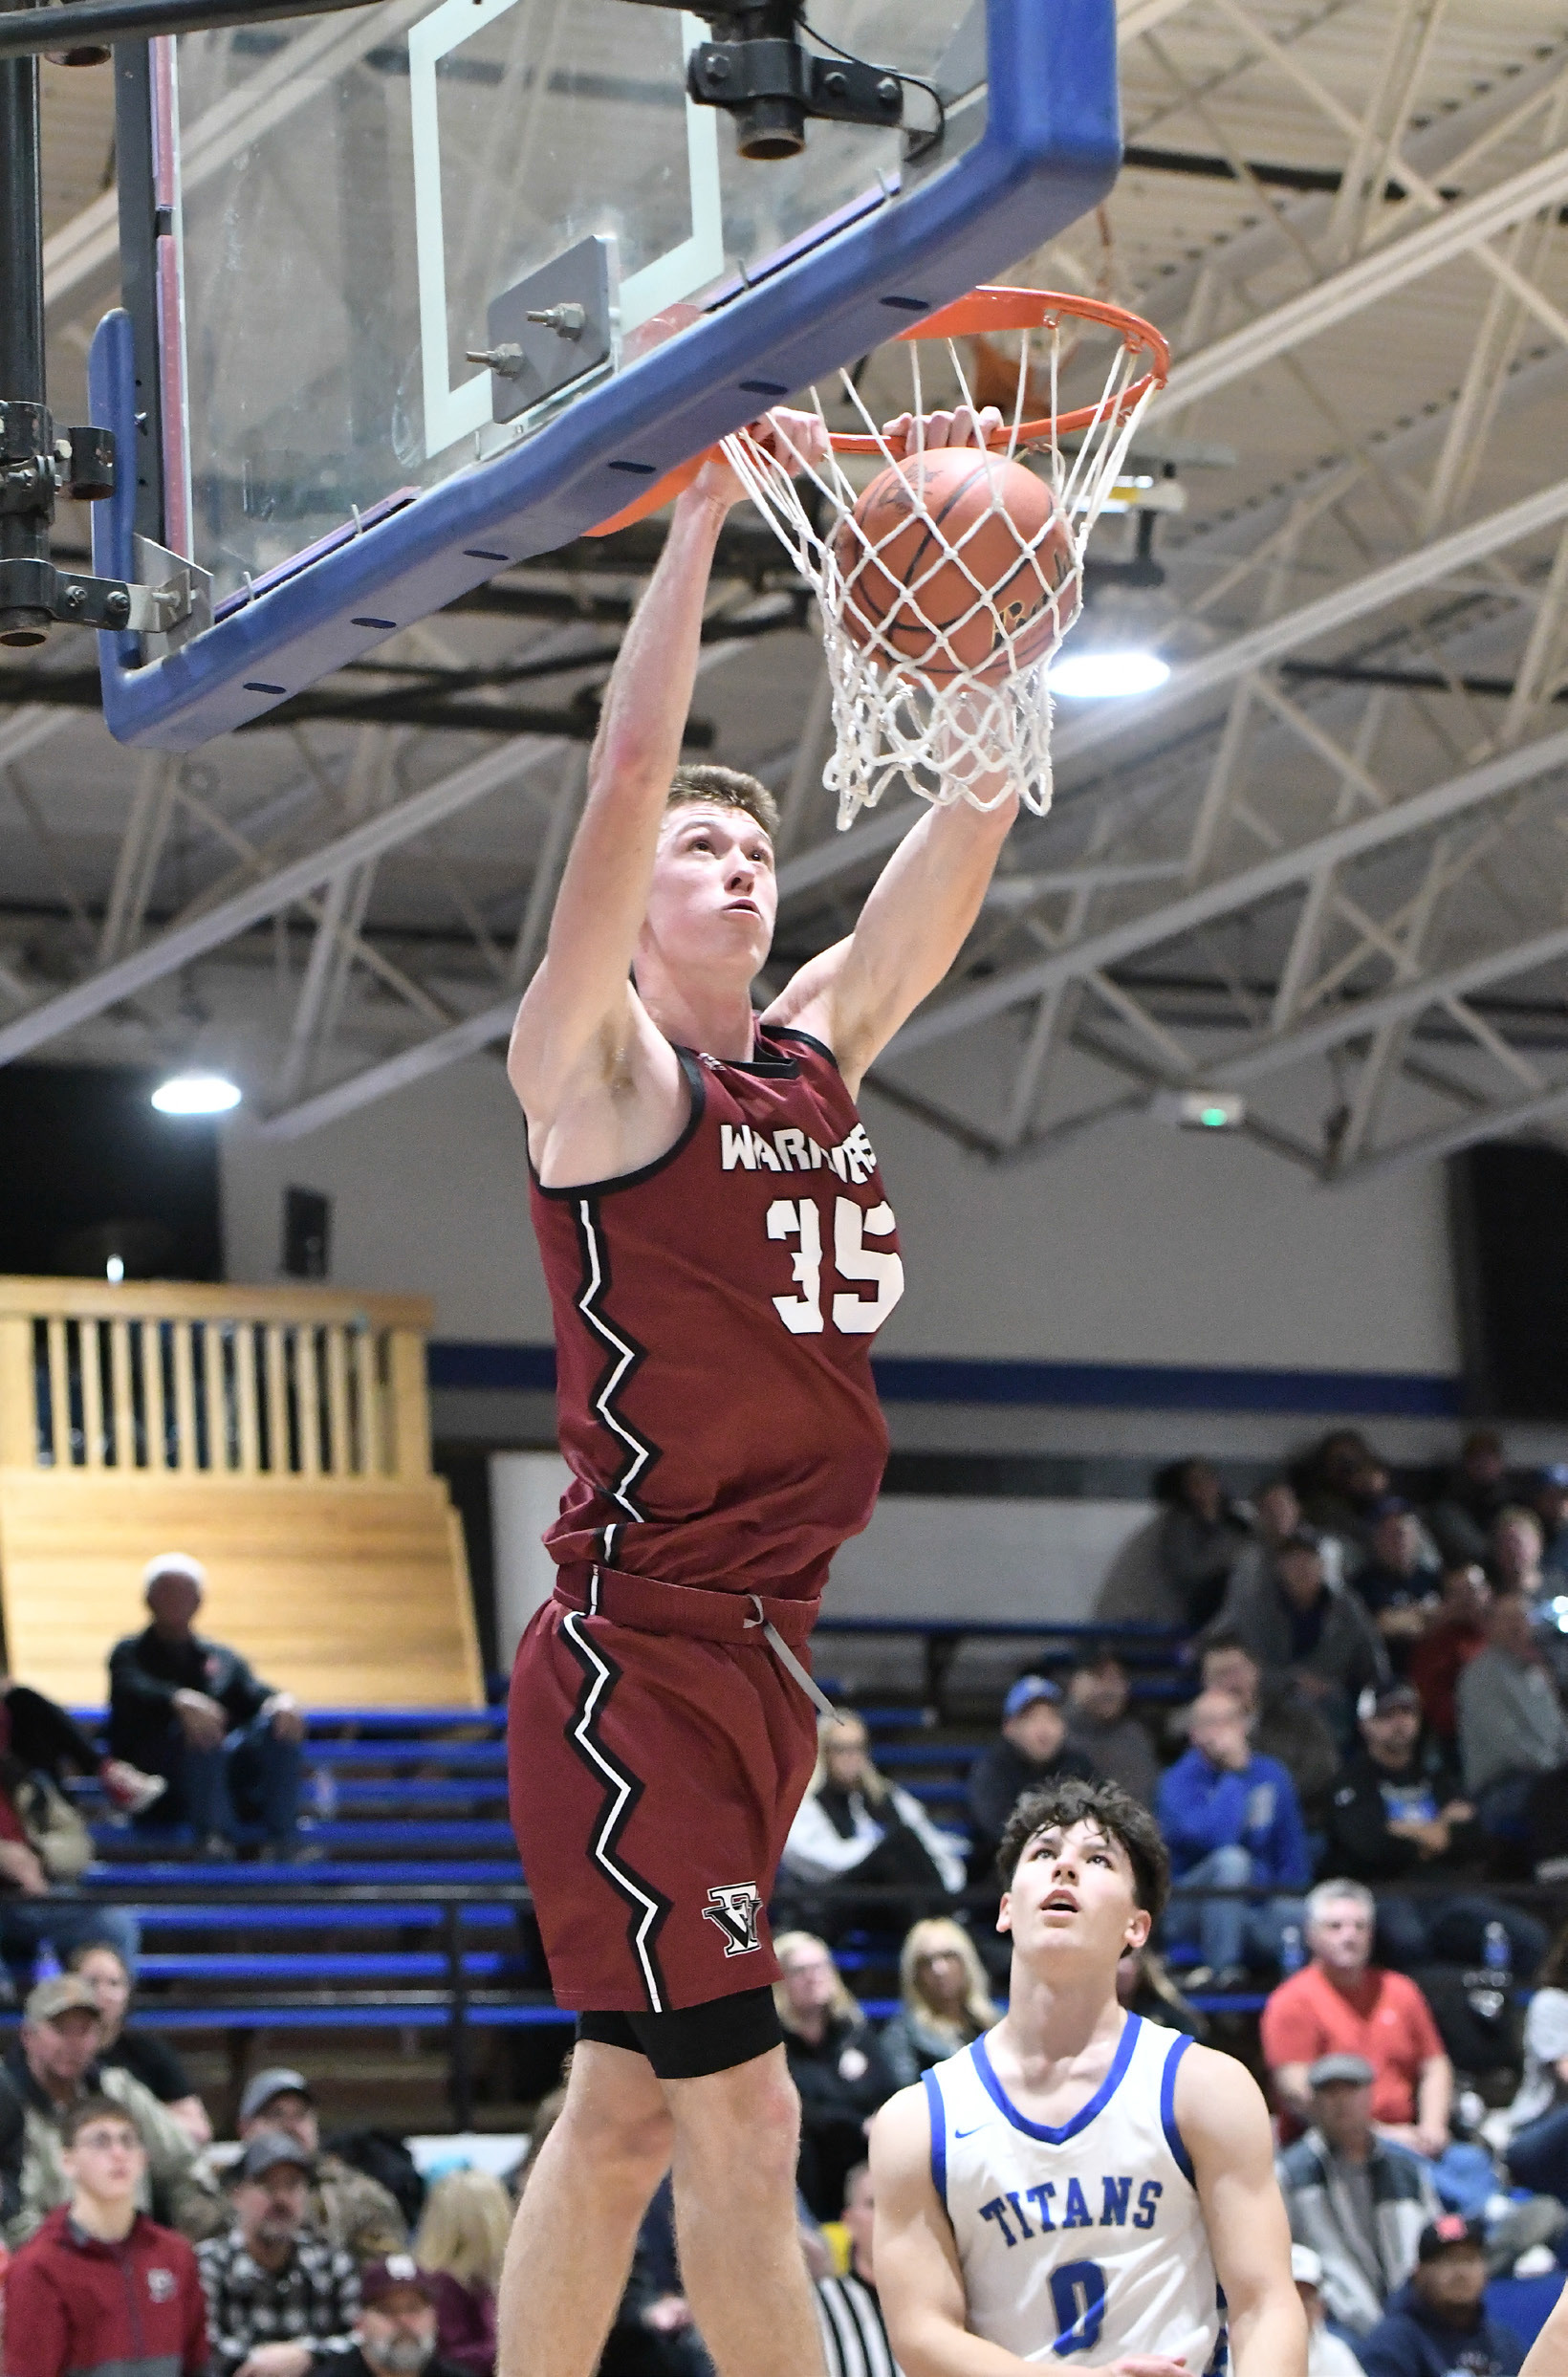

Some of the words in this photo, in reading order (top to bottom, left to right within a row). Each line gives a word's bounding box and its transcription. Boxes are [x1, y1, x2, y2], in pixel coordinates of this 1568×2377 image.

[766, 1196, 904, 1333] 35
[979, 2176, 1163, 2248] TITANS
[1049, 2257, 1106, 2357] 0
